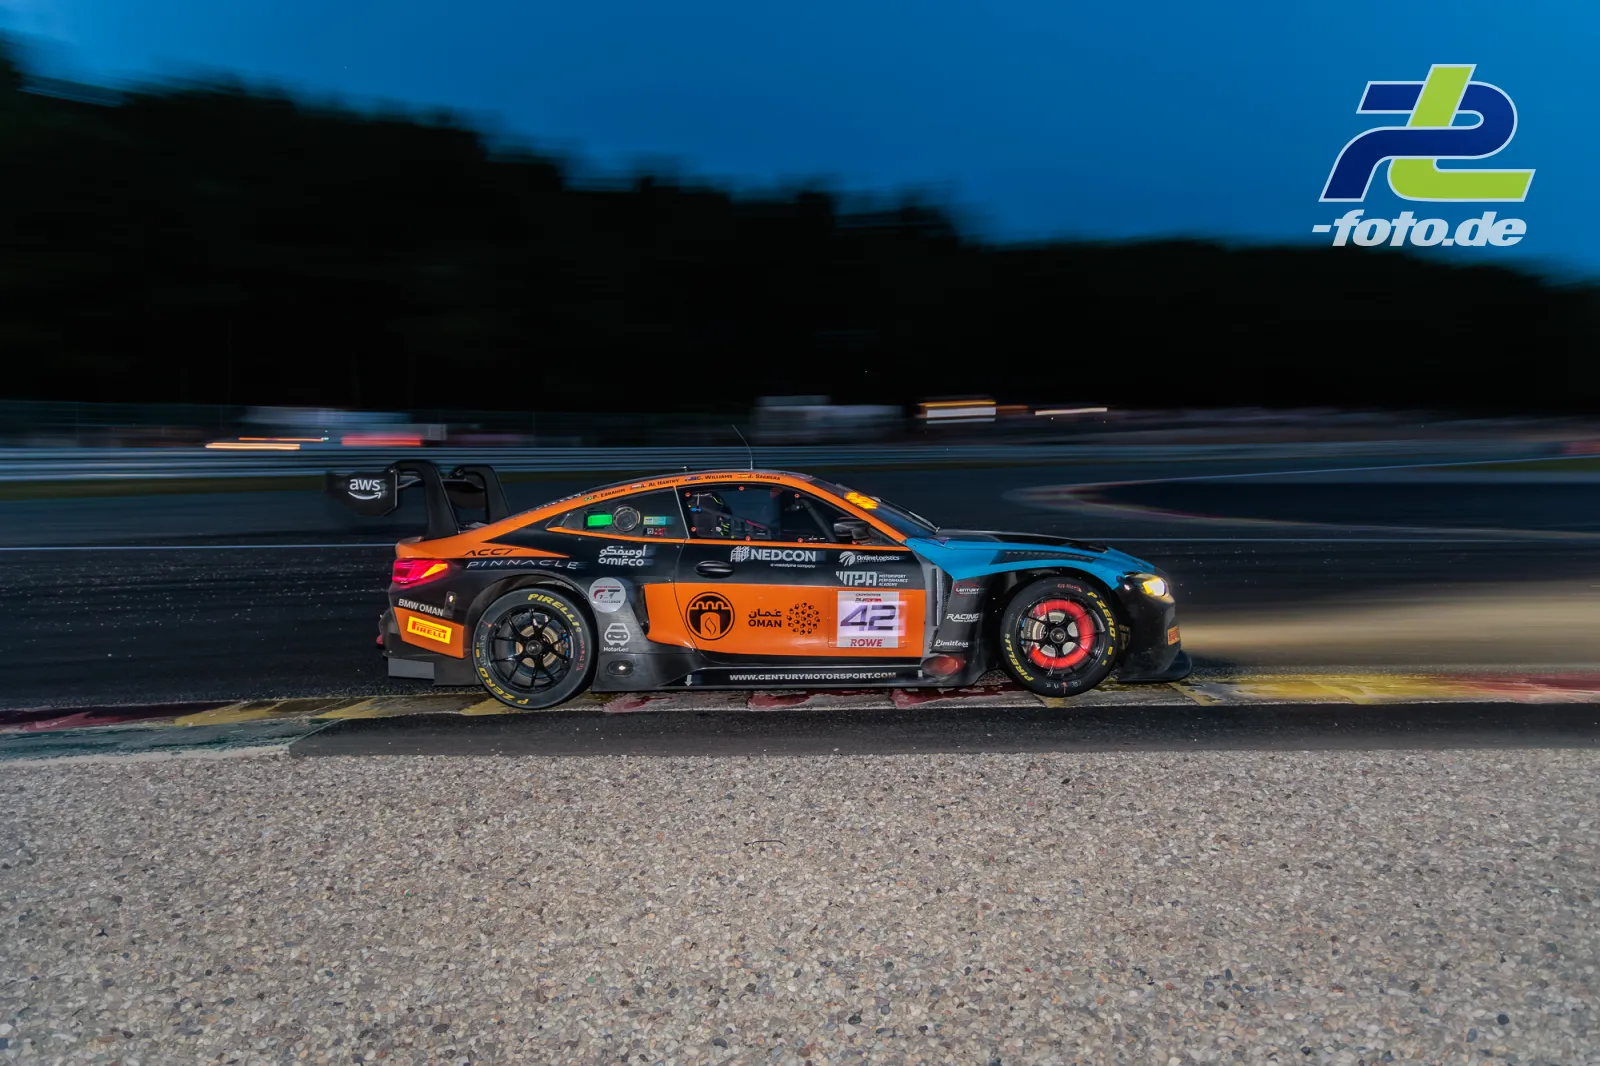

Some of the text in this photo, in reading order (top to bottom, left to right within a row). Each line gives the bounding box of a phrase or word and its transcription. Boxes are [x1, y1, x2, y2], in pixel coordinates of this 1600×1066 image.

[350, 479, 380, 491] aws
[750, 549, 816, 562] NEDCON
[466, 559, 579, 570] PINNACLE
[398, 598, 444, 616] BMW OMAN
[527, 593, 580, 627] PIRELLI
[748, 620, 782, 628] OMAN
[840, 605, 897, 631] 42
[412, 620, 447, 640] PIRELLI
[850, 638, 883, 647] ROWE
[1005, 638, 1035, 682] PIRELLI
[729, 672, 897, 681] WWW.CENTURYMOTORSPORT.COM
